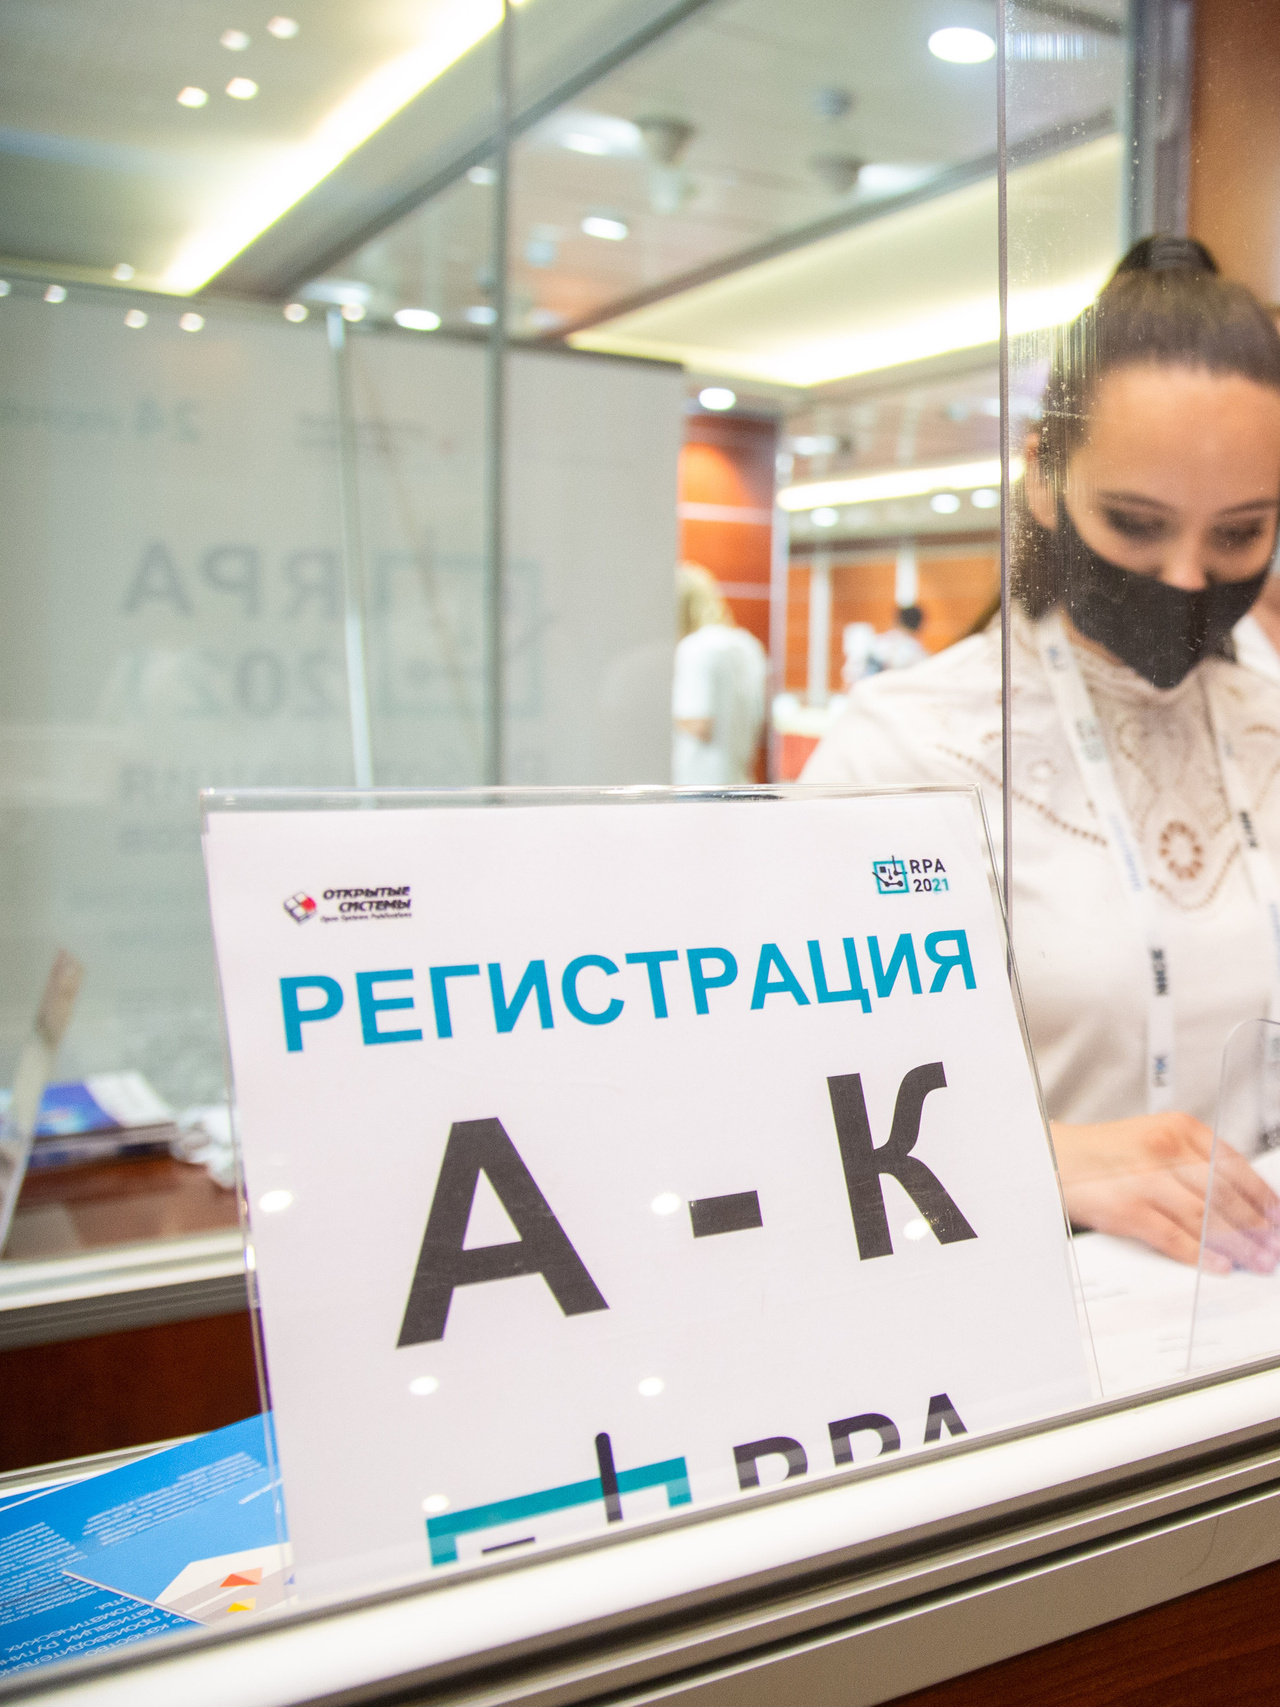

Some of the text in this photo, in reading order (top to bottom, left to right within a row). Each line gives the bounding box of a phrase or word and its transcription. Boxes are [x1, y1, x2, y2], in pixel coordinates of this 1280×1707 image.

[909, 858, 946, 874] RPA
[913, 877, 949, 892] 2021
[322, 886, 411, 901] ОТКРЫТЫЕ
[338, 899, 412, 913] СИСТЕМЫ
[278, 929, 979, 1053] РЕГИСТРАЦИЯ
[396, 1116, 610, 1350] А
[826, 1061, 978, 1261] К
